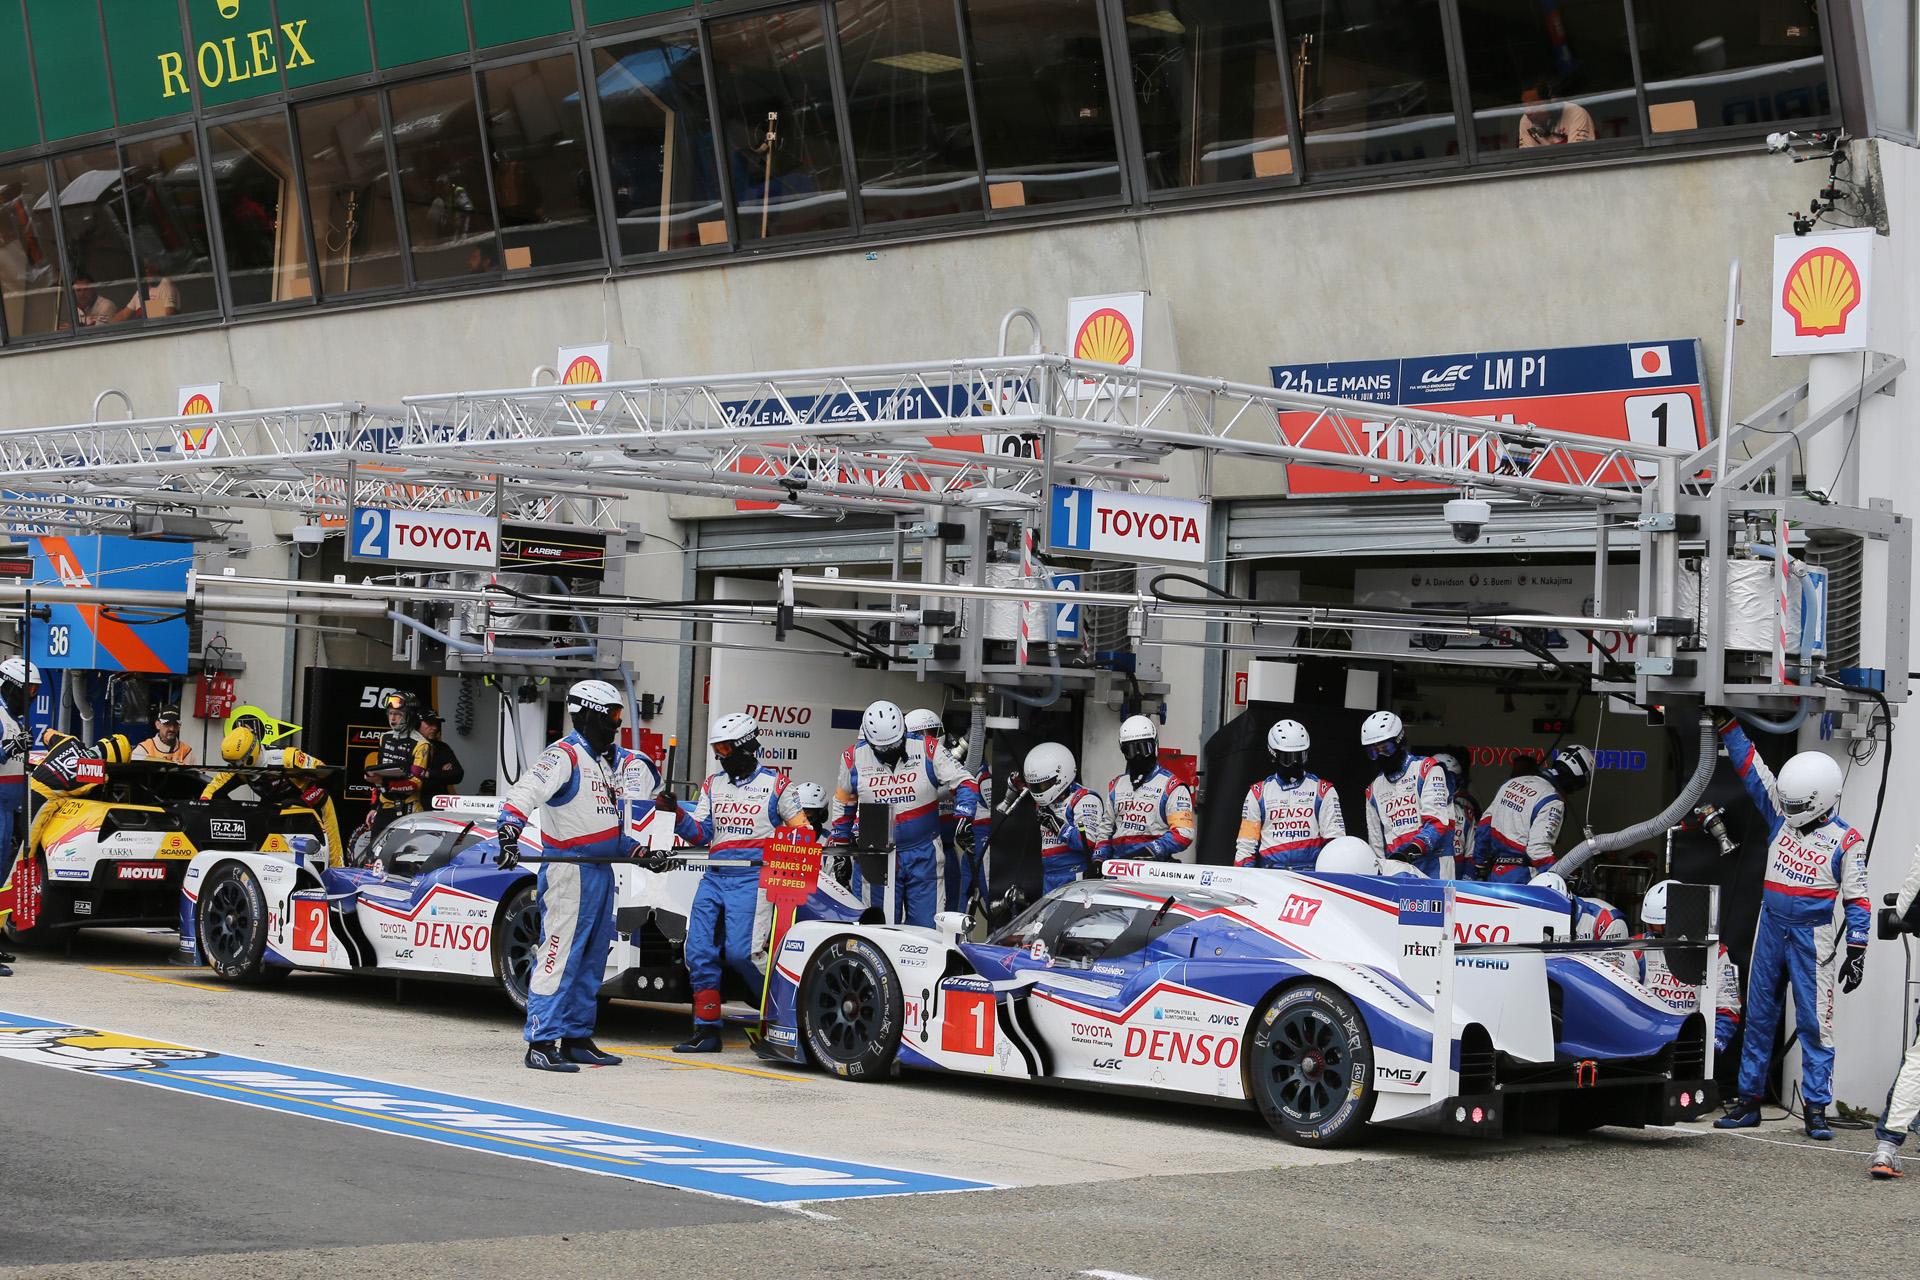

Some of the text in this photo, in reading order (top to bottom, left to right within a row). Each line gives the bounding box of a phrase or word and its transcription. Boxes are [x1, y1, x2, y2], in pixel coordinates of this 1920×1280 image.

[157, 19, 315, 98] ROLEX
[1421, 364, 1474, 383] WEC
[1483, 355, 1546, 391] LM P1
[1317, 378, 1338, 393] LE
[1341, 374, 1391, 392] MANS
[1376, 391, 1391, 400] 2015
[903, 393, 922, 420] P1
[1651, 402, 1668, 448] 1
[1063, 490, 1079, 547] 1
[1097, 507, 1201, 544] TOYOTA
[360, 509, 382, 556] 2
[395, 524, 492, 553] TOYOTA
[528, 546, 562, 557] LARBRE
[1425, 577, 1573, 588] A. Davidson S. Buemi K. Nakajima
[1056, 579, 1076, 633] 2
[49, 626, 69, 656] 36
[580, 698, 609, 715] uvex
[745, 704, 812, 725] DENSO
[264, 723, 274, 736] 50
[775, 729, 811, 739] HYBRID
[734, 731, 756, 747] uvex
[755, 747, 797, 760] Mobil 1
[77, 763, 104, 778] MOTUL
[868, 772, 917, 788] DENSO
[872, 787, 916, 798] TOYOTA
[1507, 780, 1538, 798] DENSO
[434, 796, 461, 808] ZENT
[1500, 798, 1524, 813] HYBRID
[1504, 790, 1526, 806] TOYOTA
[714, 802, 762, 815] DENSO
[1117, 801, 1154, 813] DENSO
[1269, 807, 1314, 821] DENSO
[212, 822, 245, 833] B.R.M
[716, 816, 755, 827] TOYOTA
[1272, 821, 1311, 830] TOYOTA
[716, 825, 753, 836] HYBRID
[791, 827, 798, 846] 1
[1272, 830, 1311, 838] HYBRID
[772, 843, 823, 857] IGNITION OFF
[1778, 835, 1828, 866] DENSO
[770, 860, 813, 873] BRAKES ON
[1107, 861, 1146, 878] ZENT
[1777, 850, 1818, 878] TOYOTA
[119, 867, 165, 880] MOTUL
[1212, 876, 1233, 885] zf.com
[1773, 860, 1815, 886] HYBRID
[768, 876, 806, 889] PIT SPEED
[1282, 896, 1318, 921] HY
[1399, 898, 1442, 913] Mobil 1
[309, 907, 325, 947] 2
[380, 922, 407, 934] TOYOTA
[413, 921, 490, 952] DENSO
[395, 949, 414, 959] WEC
[544, 934, 560, 975] DENSO
[899, 944, 929, 955] RAYS
[1403, 941, 1438, 957] JTEKT
[859, 944, 884, 975] MICHELIN
[1455, 956, 1510, 971] HYBRID
[1091, 964, 1125, 976] NISSHINBO
[1278, 990, 1313, 1007] MICHELIN
[1653, 986, 1696, 1000] TOYOTA
[905, 1000, 918, 1027] P1
[969, 1001, 986, 1049] 1
[1071, 1022, 1113, 1039] TOYOTA
[768, 1026, 796, 1041] MICHELIN
[1092, 1039, 1113, 1047] Racing
[1123, 1026, 1239, 1069] DENSO
[1093, 1058, 1123, 1070] WEC
[1376, 1066, 1412, 1081] TMG
[170, 1069, 908, 1187] MICHELIN
[1321, 1104, 1353, 1136] MICHELIN
